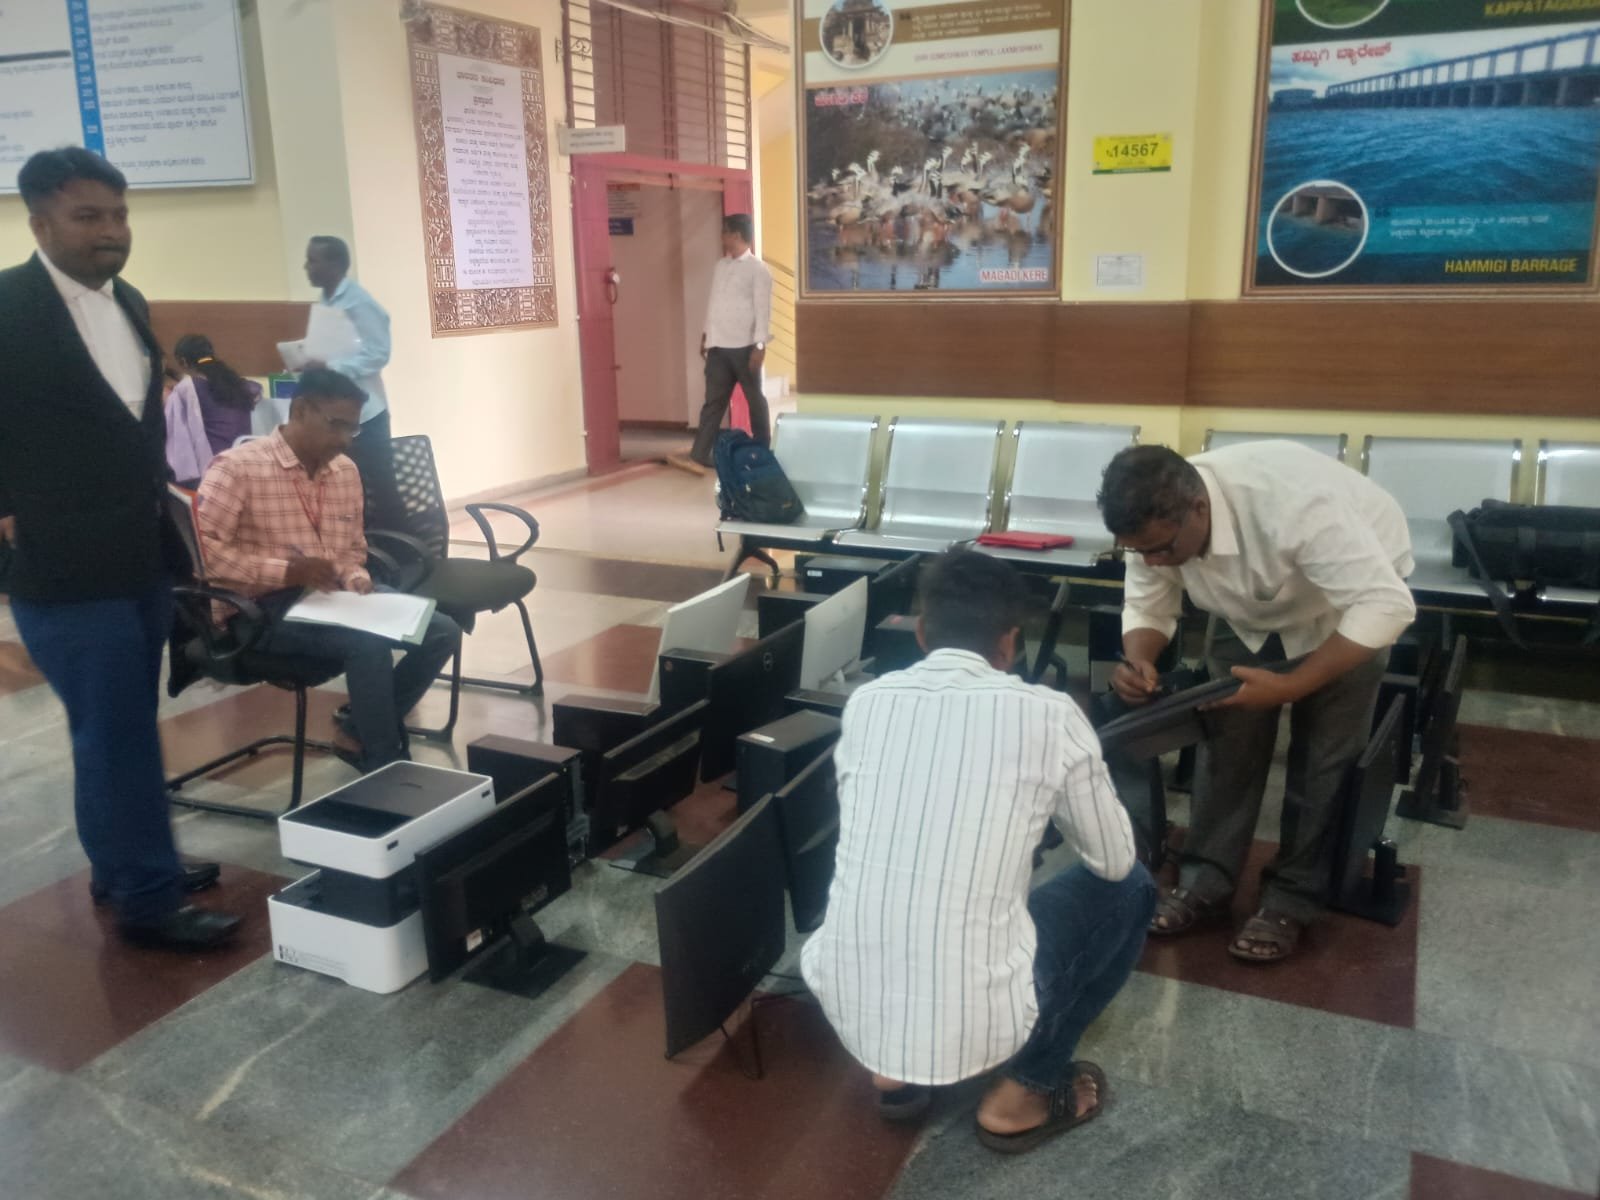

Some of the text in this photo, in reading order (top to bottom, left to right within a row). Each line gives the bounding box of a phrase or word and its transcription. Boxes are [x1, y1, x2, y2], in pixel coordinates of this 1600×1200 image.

[1112, 142, 1159, 158] 14567
[1444, 257, 1577, 273] HAMMIGI BARRAGE
[981, 269, 1048, 281] MAGADI KERE
